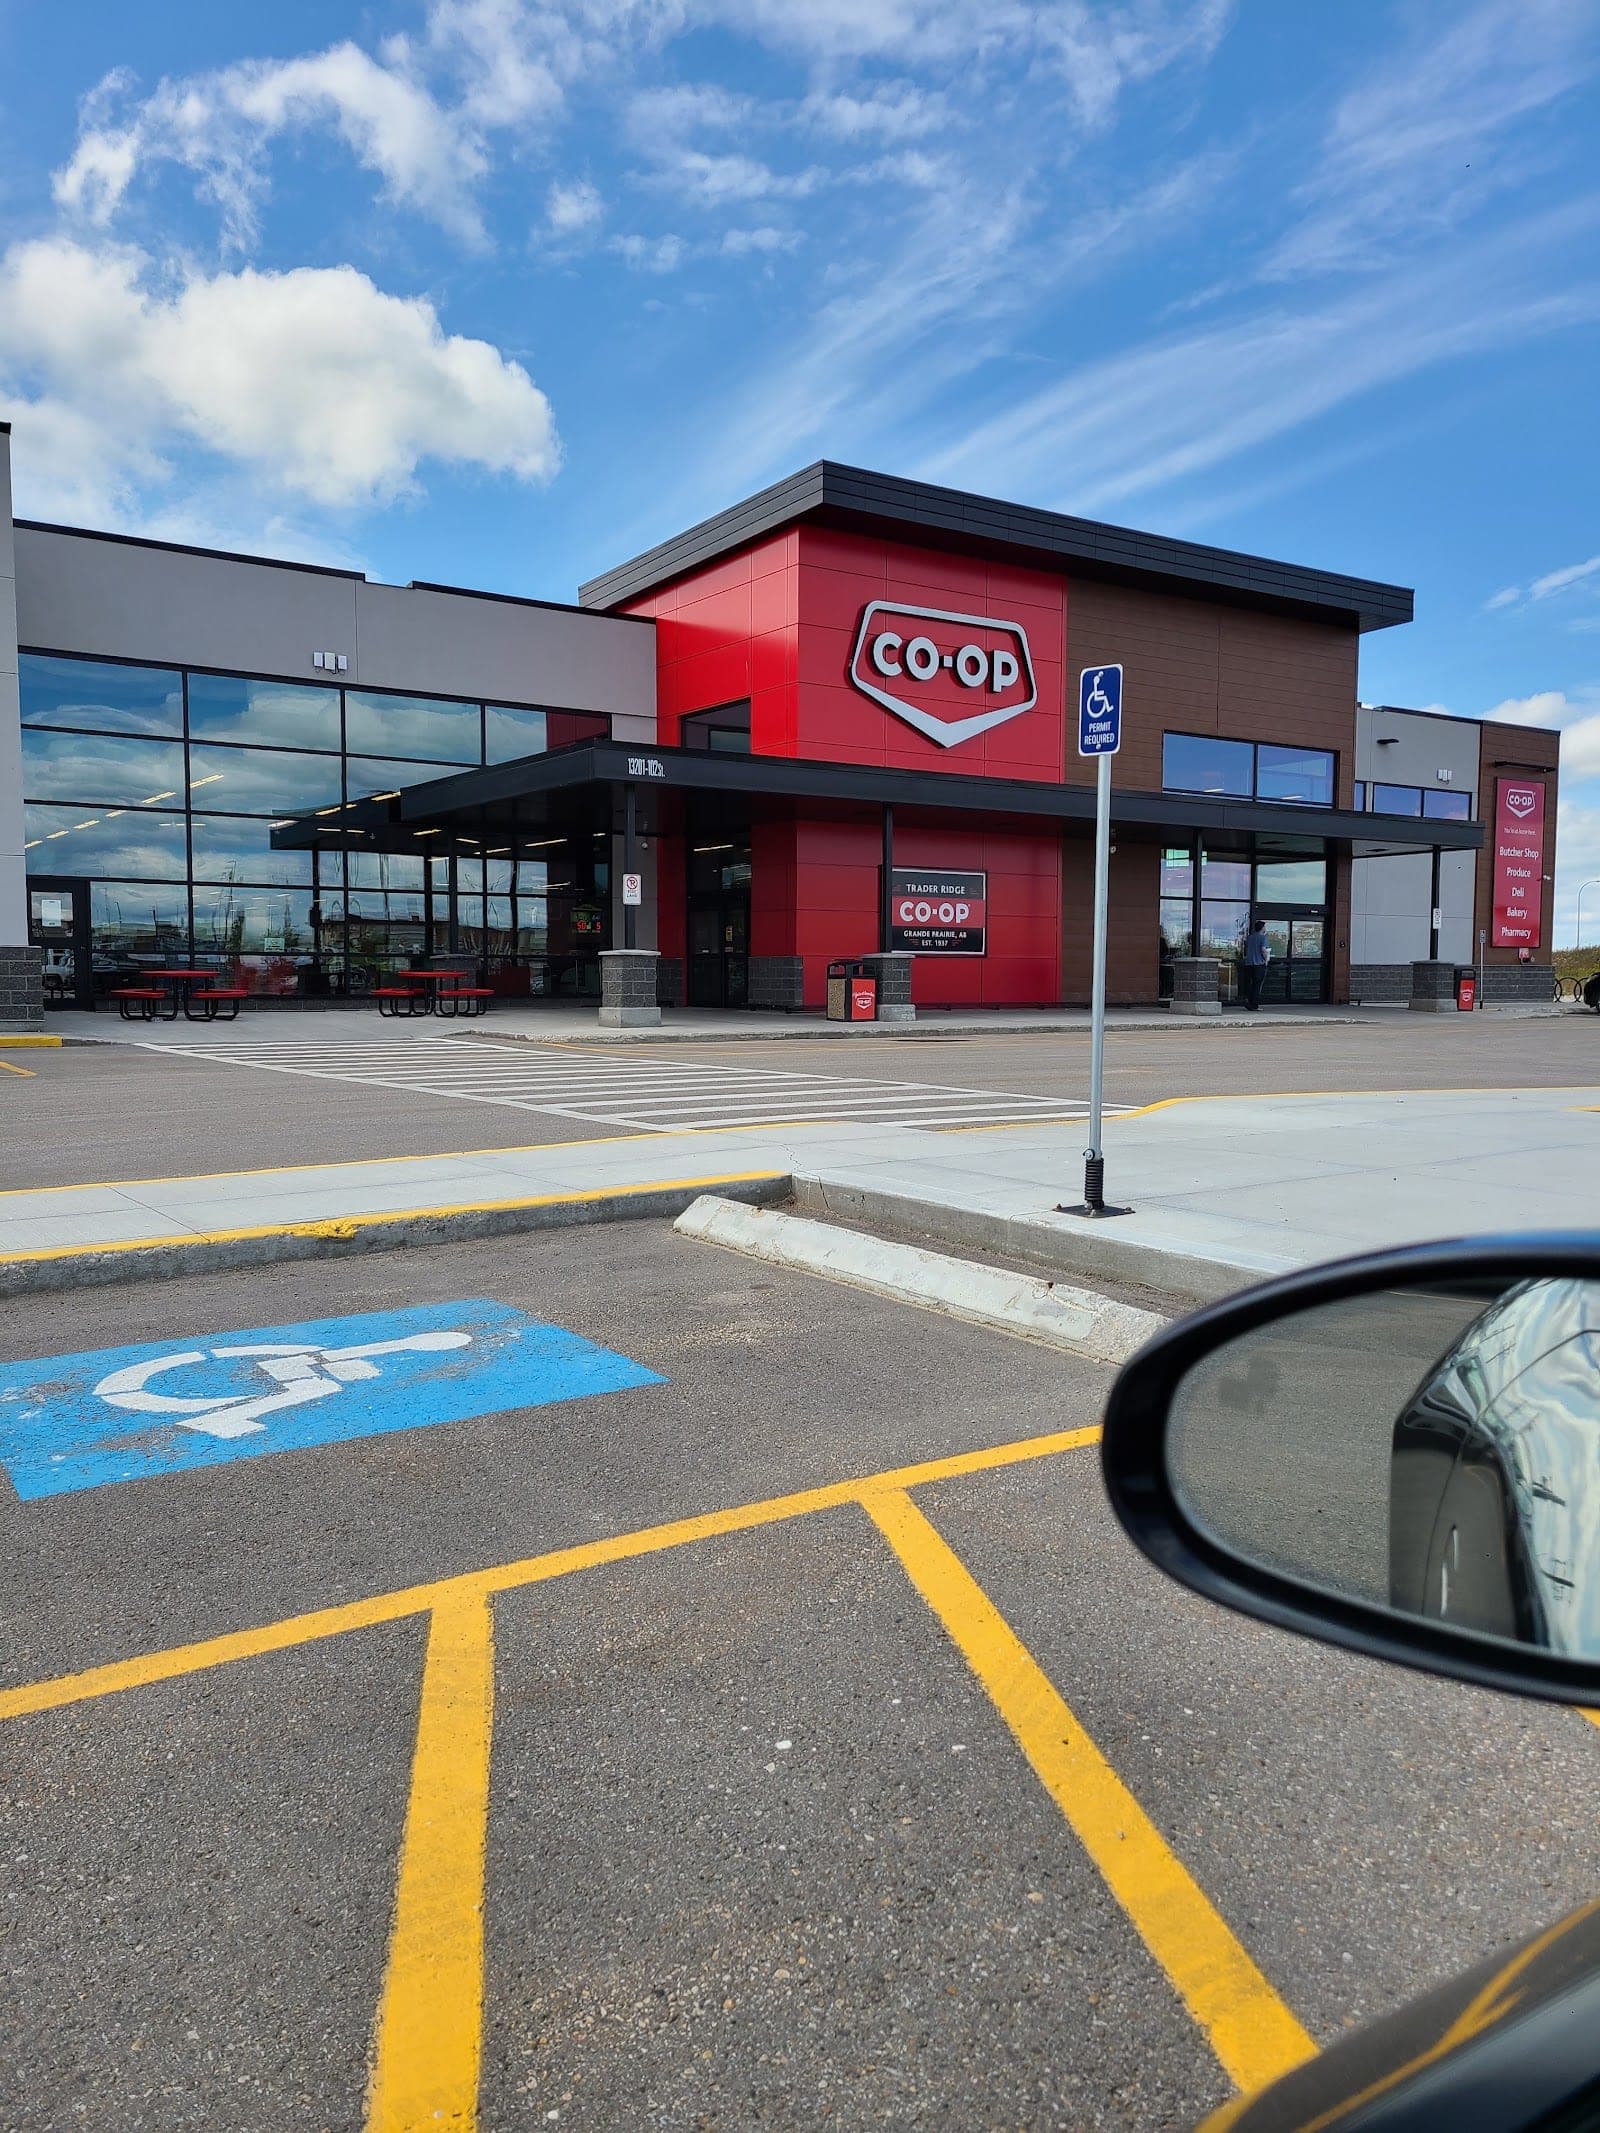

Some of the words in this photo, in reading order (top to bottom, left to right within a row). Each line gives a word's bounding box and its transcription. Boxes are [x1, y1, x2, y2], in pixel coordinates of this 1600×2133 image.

[873, 632, 1018, 692] CO-OP
[1089, 721, 1112, 733] PERMIT
[1084, 733, 1115, 745] REQUIRED
[1509, 795, 1533, 806] CO-OP
[1500, 846, 1523, 857] Butcher
[1524, 848, 1539, 860] Shop
[1506, 867, 1531, 878] Produce
[906, 884, 938, 893] TRADER
[940, 885, 965, 894] RIDGE
[1511, 887, 1524, 897] Deli
[900, 901, 969, 923] CO-OP
[1507, 907, 1528, 919] Bakery
[1501, 926, 1531, 939] Pharmacy
